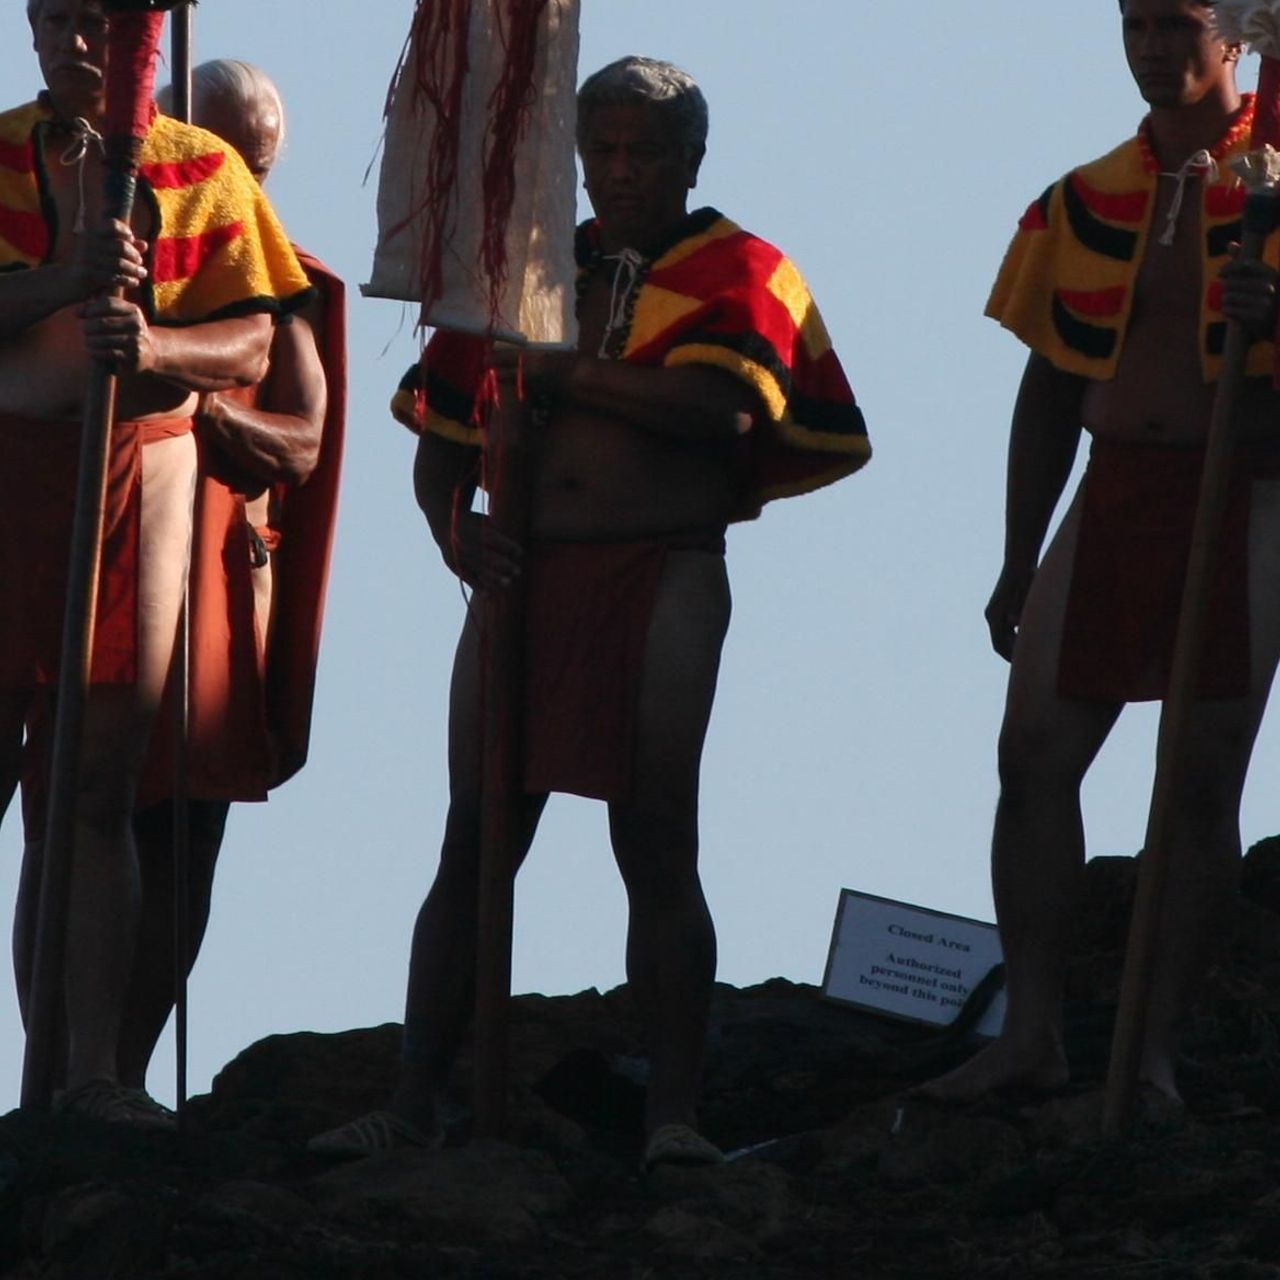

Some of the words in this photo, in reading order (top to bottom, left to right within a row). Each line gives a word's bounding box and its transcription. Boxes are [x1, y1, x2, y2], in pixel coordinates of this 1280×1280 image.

[887, 924, 934, 944] Closed
[937, 937, 971, 953] Area
[886, 952, 962, 980] Authorized
[859, 974, 909, 995] beyond
[912, 986, 937, 1001] this
[870, 964, 938, 988] personnel
[940, 981, 970, 997] only
